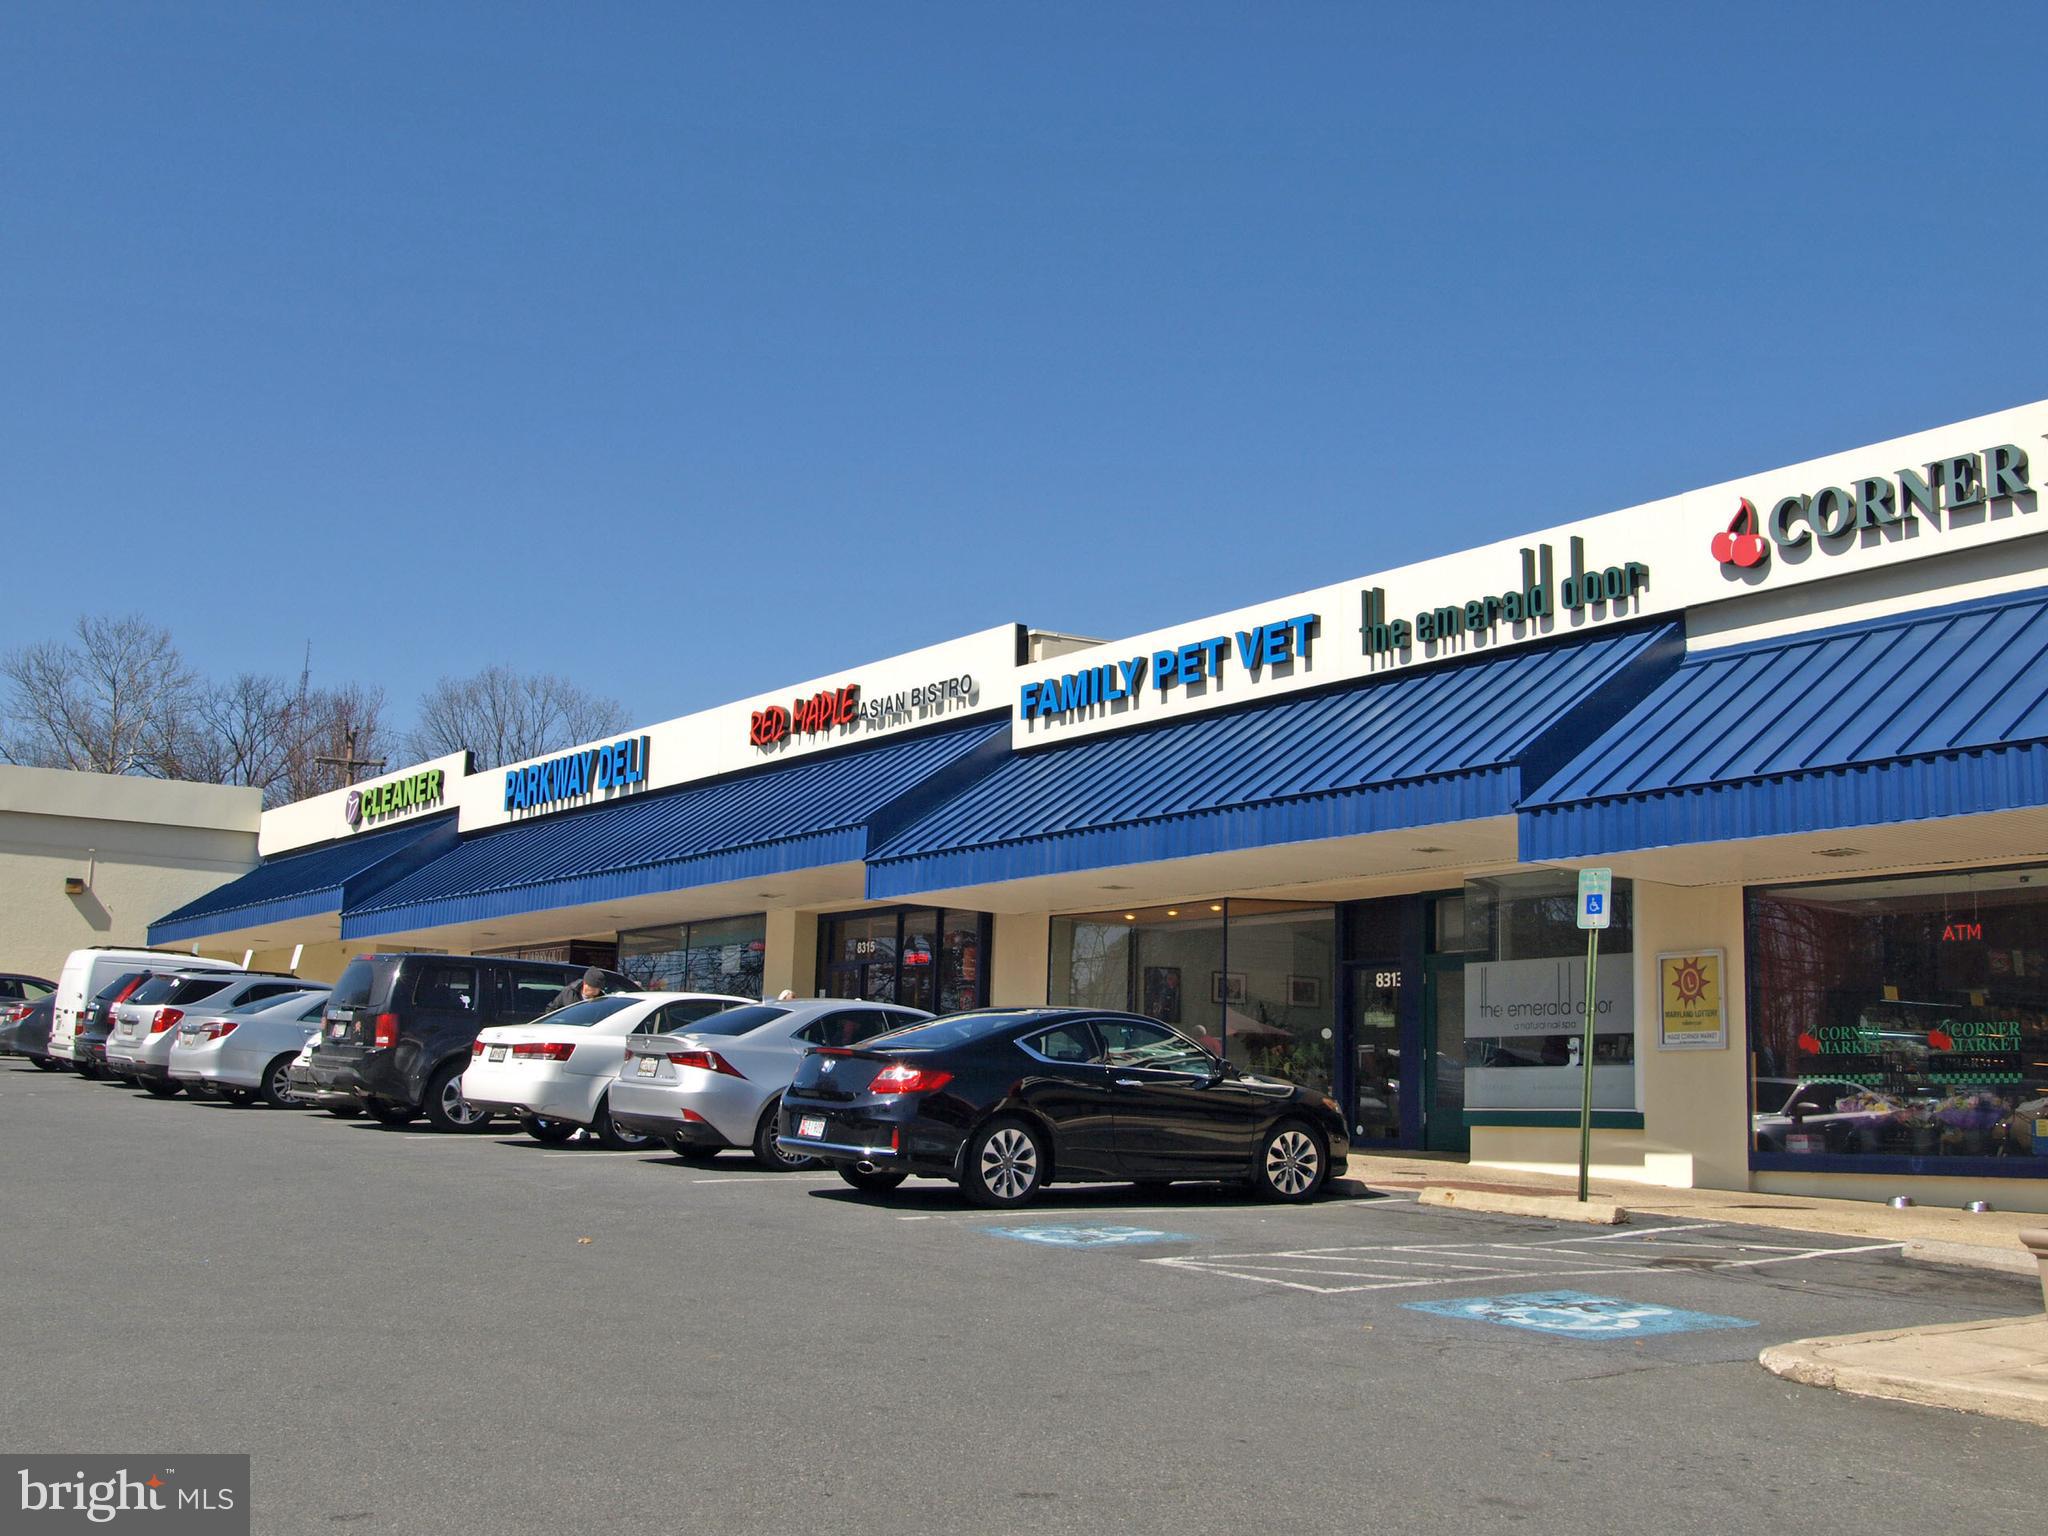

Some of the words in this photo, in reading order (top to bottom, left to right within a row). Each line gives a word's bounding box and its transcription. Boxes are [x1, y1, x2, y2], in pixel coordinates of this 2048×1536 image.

[1769, 444, 2030, 546] CORNER
[1359, 587, 1411, 656] the
[1416, 544, 1552, 642] emerald
[1561, 536, 1649, 610] door
[1021, 656, 1146, 720] FAMILY
[1152, 636, 1230, 690] PET
[1235, 613, 1319, 670] VET
[750, 706, 789, 745] RED
[793, 684, 859, 734] MAPLE
[859, 691, 905, 720] ASIAN
[911, 674, 972, 707] BISTRO
[361, 769, 443, 818] CLEANER
[504, 749, 599, 811] PARKWAY
[599, 735, 650, 790] DELI
[857, 941, 875, 953] 8315
[1943, 923, 1982, 941] ATM
[1480, 967, 1502, 1018] the
[1507, 962, 1570, 1017] emerald
[1817, 1040, 1882, 1054] MARKET
[1819, 1025, 1881, 1040] CORNER
[1951, 1021, 2021, 1038] CORNER
[1951, 1037, 2022, 1051] MARKET
